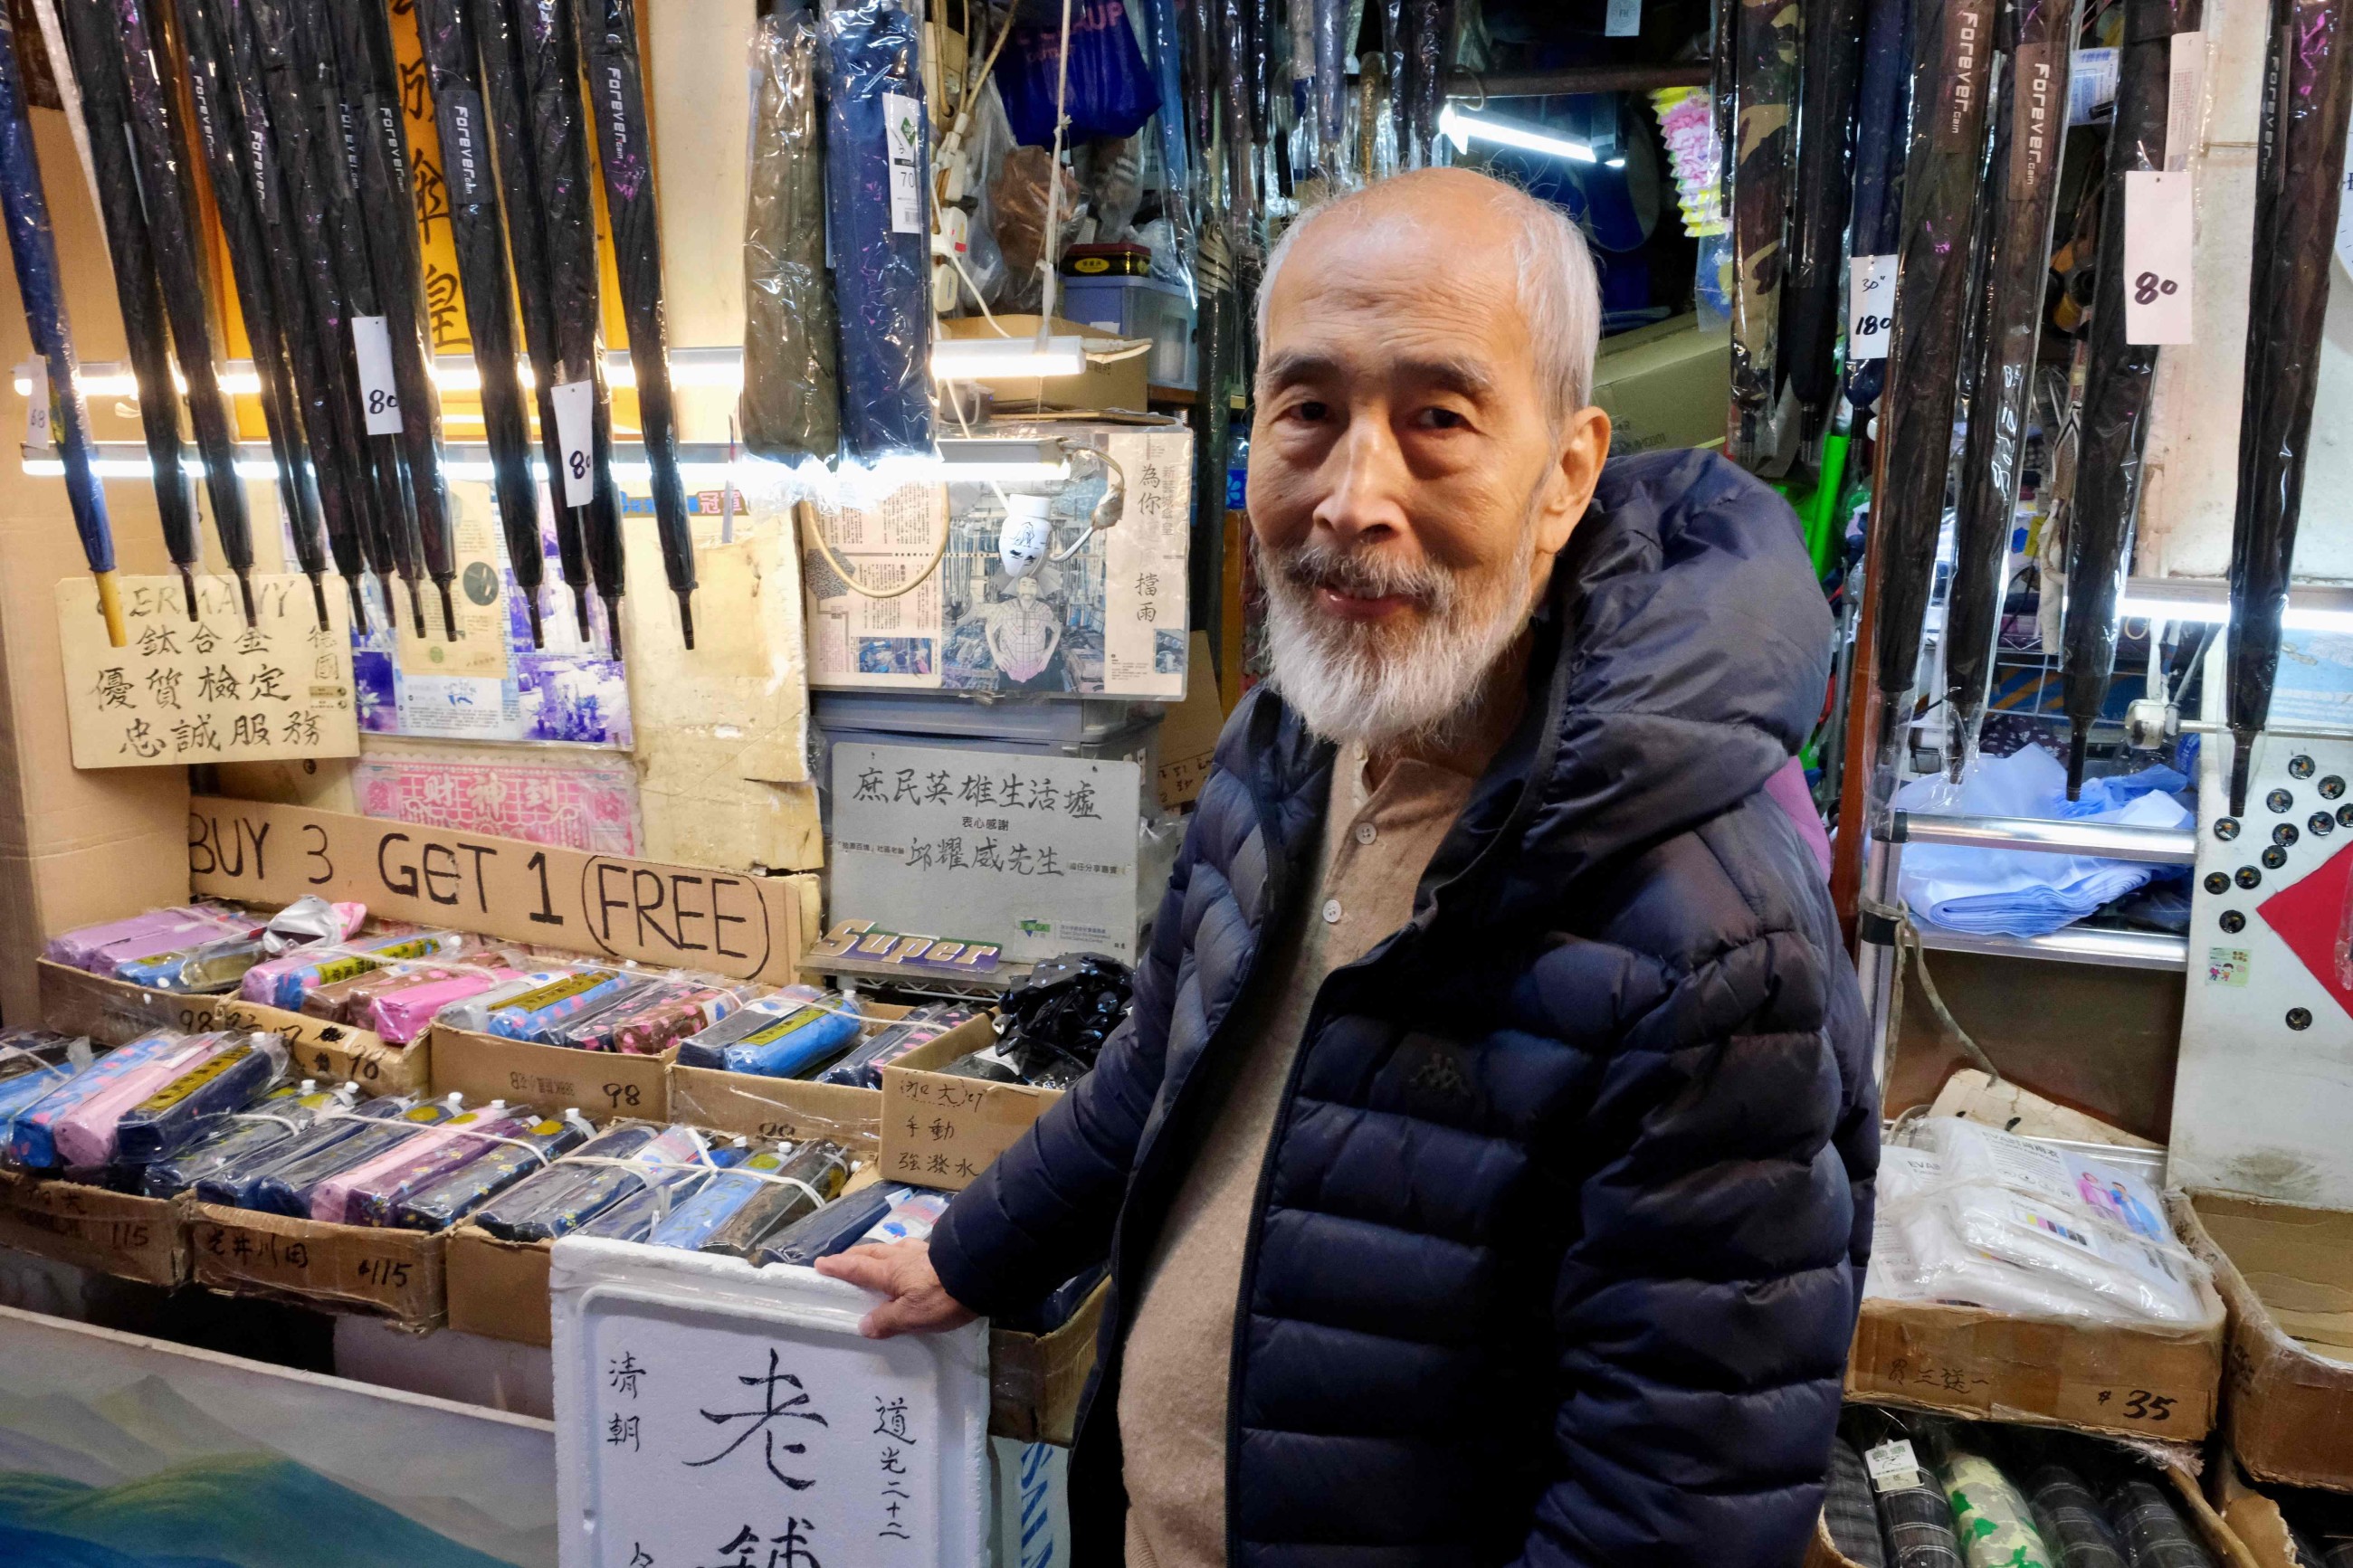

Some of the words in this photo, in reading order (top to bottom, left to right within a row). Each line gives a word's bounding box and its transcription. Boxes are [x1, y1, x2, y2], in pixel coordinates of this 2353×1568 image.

[2134, 271, 2177, 305] 80
[1855, 315, 1891, 336] 180
[368, 389, 398, 414] 80
[90, 663, 292, 712] 優質檢定
[119, 709, 324, 758] 忠誠服務
[962, 816, 1010, 832] 衷心感謝
[188, 813, 270, 879] BUY
[302, 824, 334, 884] 3
[378, 832, 498, 913] GET
[528, 851, 564, 926] 1
[811, 918, 1001, 965] Super
[180, 1010, 214, 1033] 98
[602, 1083, 641, 1108] 98
[906, 1115, 955, 1141] 手動
[111, 1222, 149, 1251] 115
